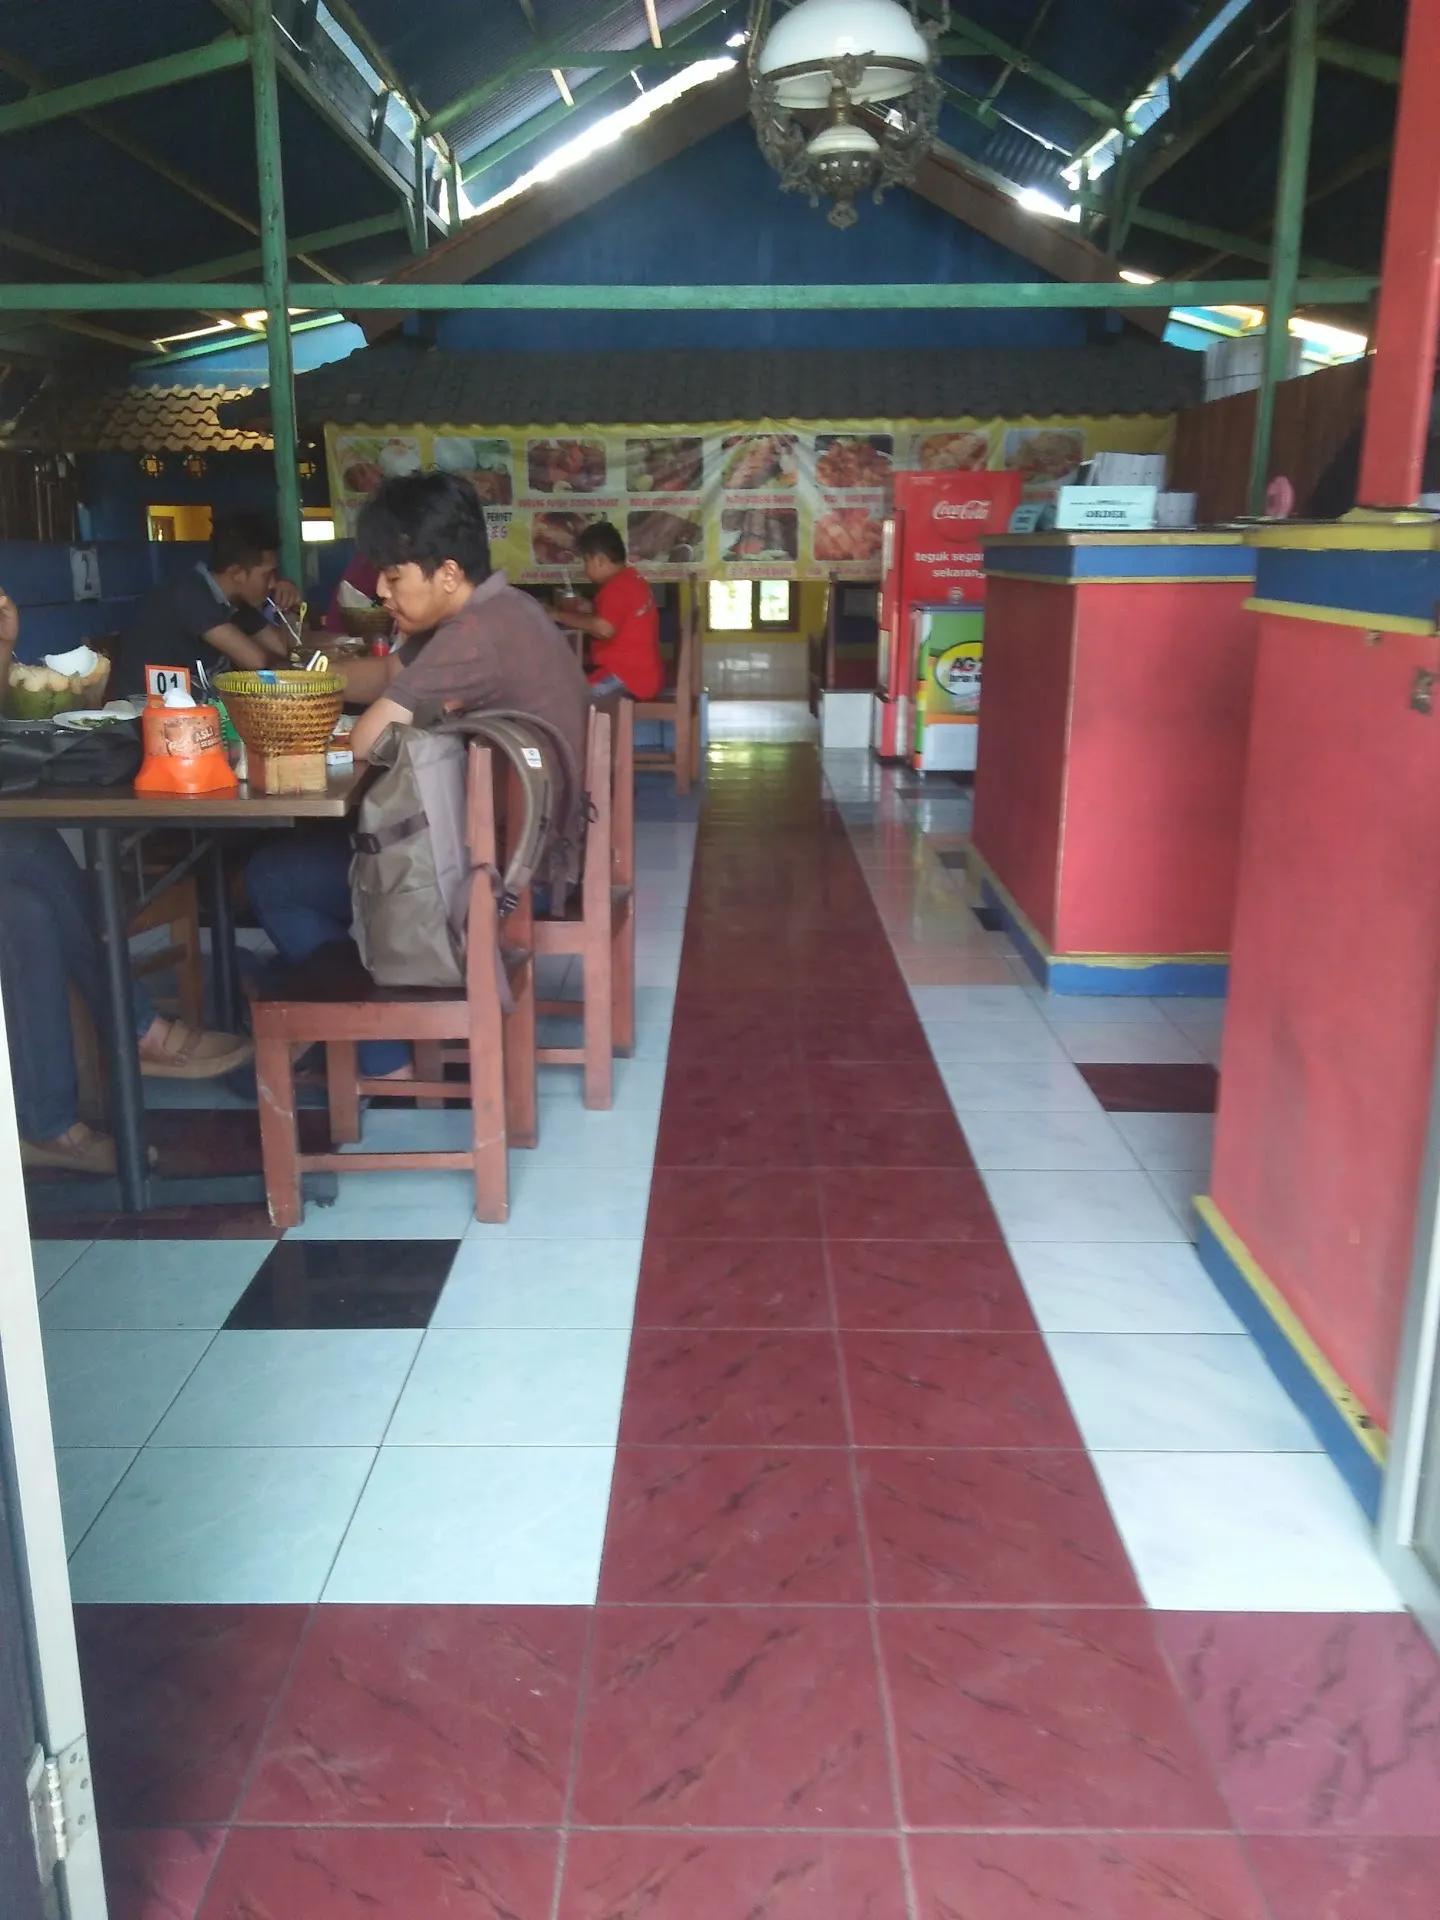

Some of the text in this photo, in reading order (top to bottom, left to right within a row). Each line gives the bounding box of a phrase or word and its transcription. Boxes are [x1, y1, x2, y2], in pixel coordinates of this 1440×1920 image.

[1086, 510, 1127, 518] ORDER
[915, 552, 950, 563] teguk
[157, 672, 178, 694] 01
